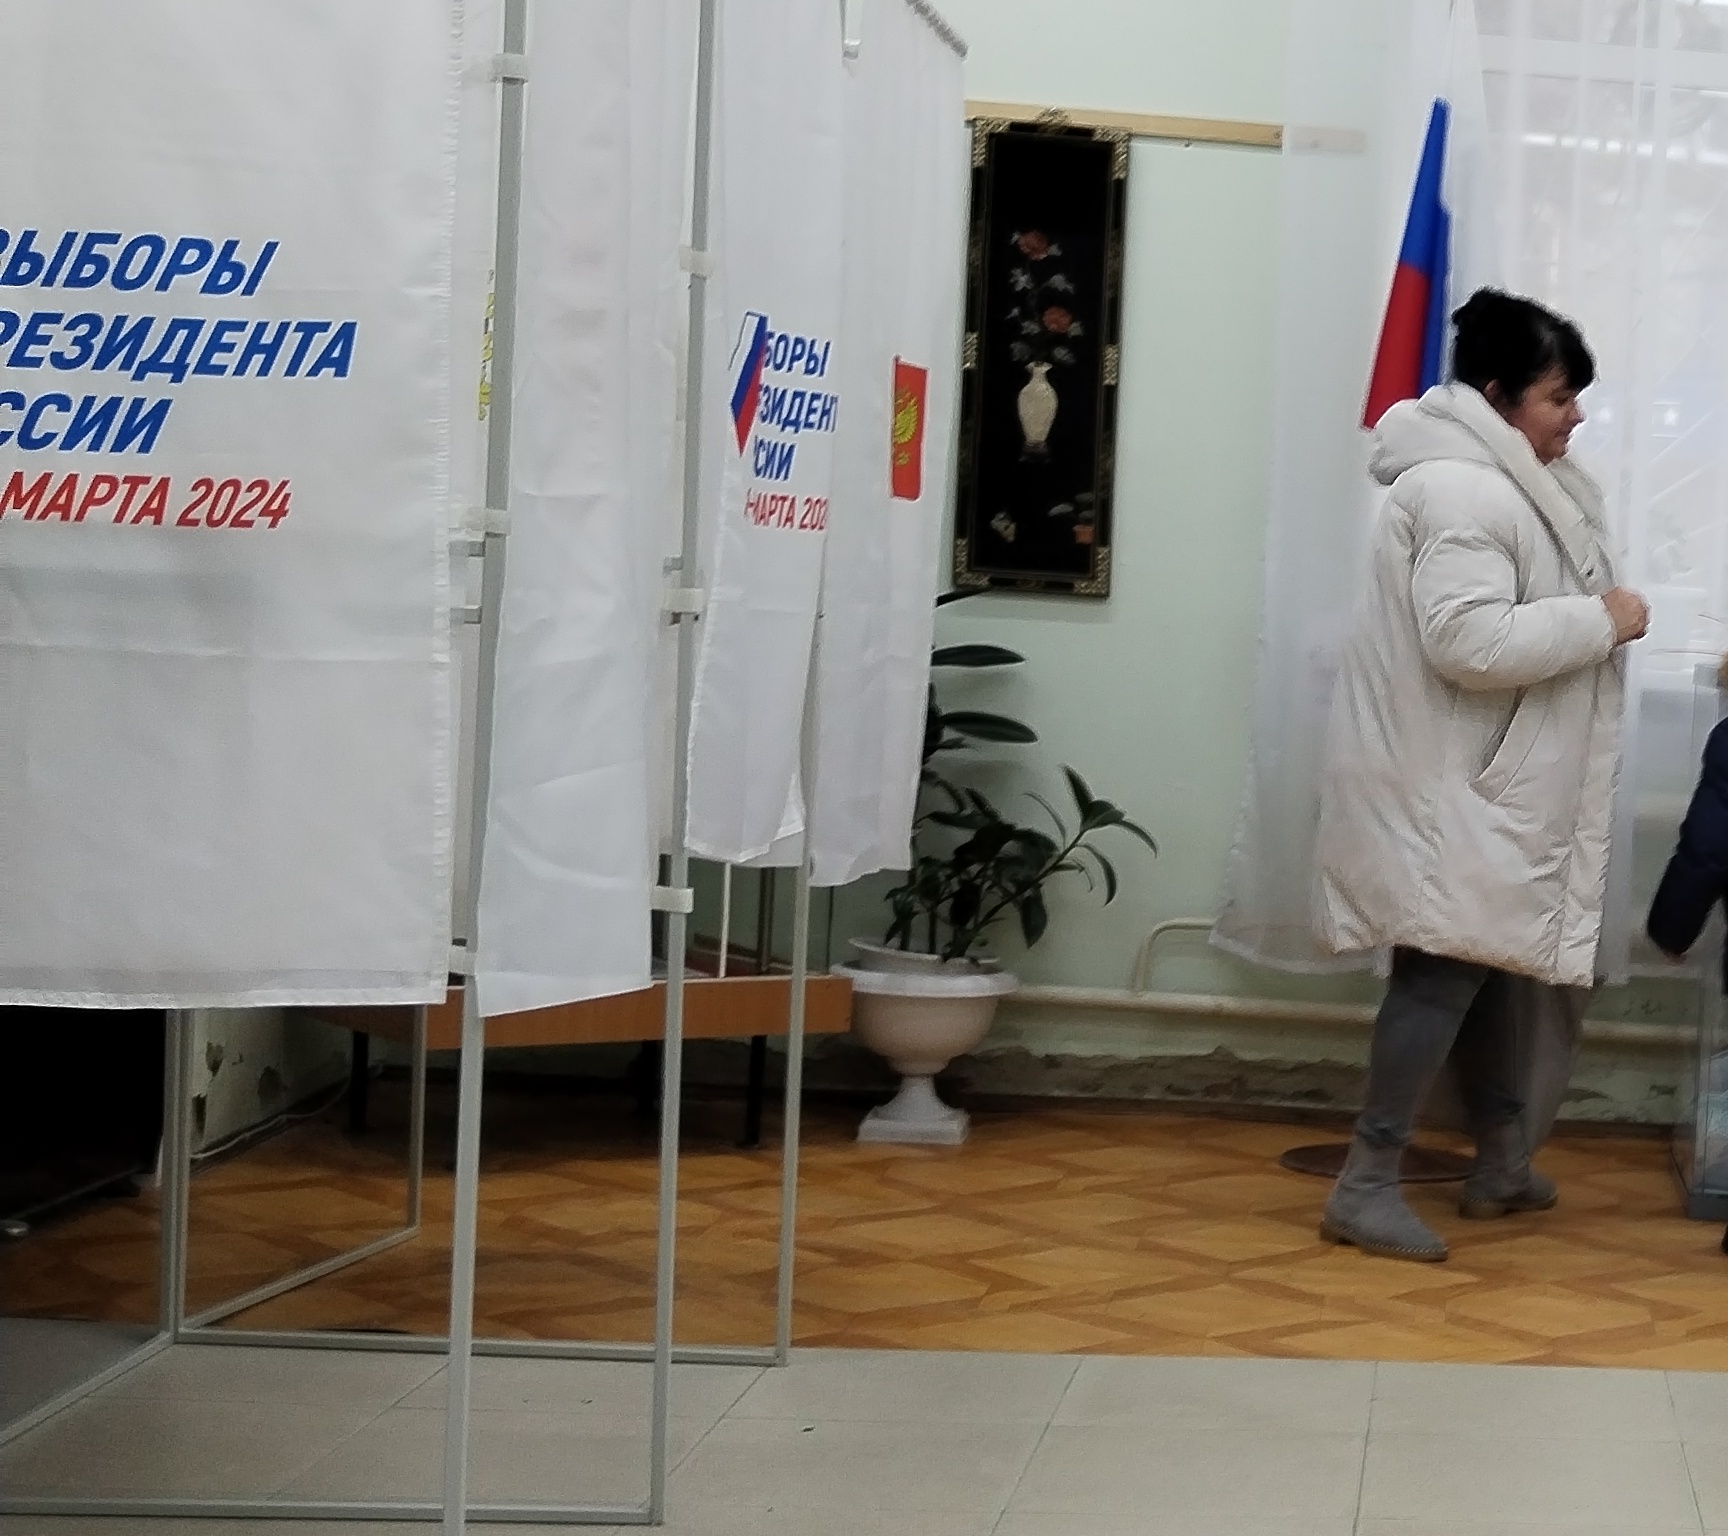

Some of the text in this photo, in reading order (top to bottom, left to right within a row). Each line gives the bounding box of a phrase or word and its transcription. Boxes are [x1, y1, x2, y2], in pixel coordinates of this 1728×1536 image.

[757, 384, 839, 434] ЗИДЕН
[754, 435, 797, 482] СИИ
[0, 469, 292, 529] МАРТА 2024
